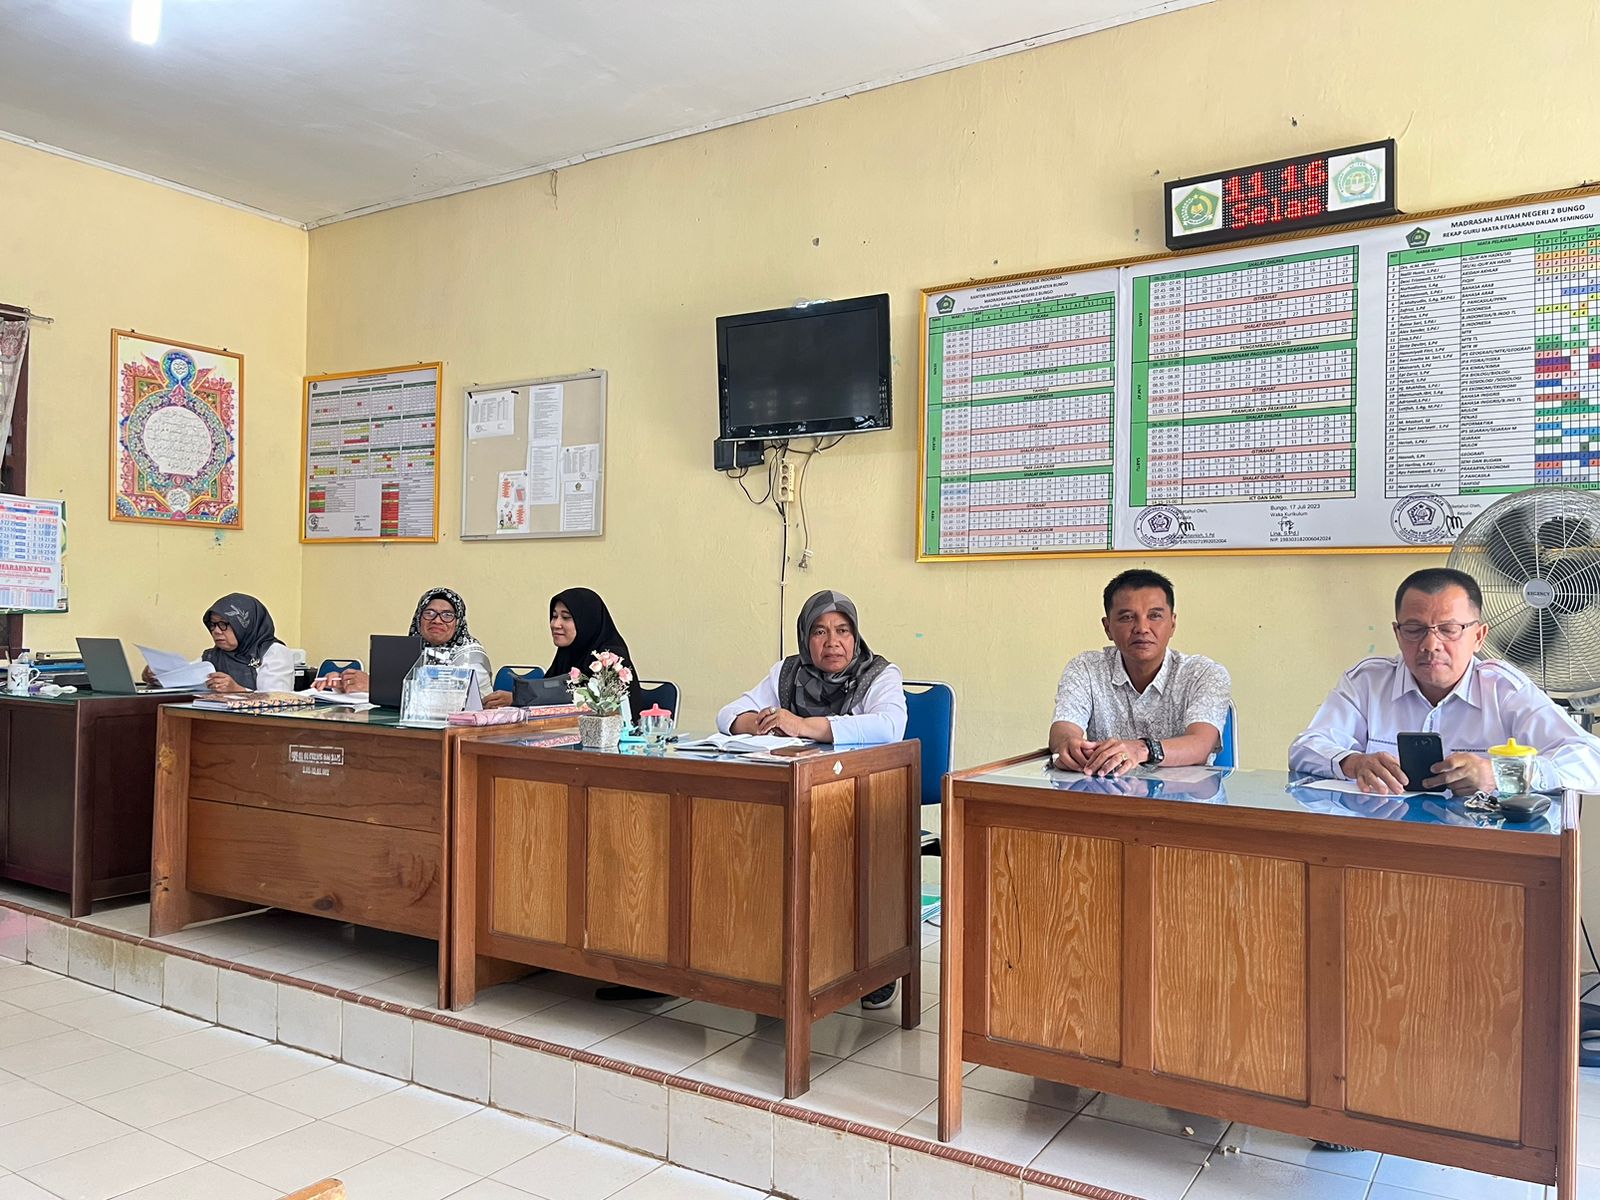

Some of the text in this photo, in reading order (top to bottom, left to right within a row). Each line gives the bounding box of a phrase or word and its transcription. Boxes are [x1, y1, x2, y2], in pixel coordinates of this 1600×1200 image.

[1451, 217, 1493, 228] MADRASAH
[1494, 213, 1520, 222] ALIYAH
[1522, 209, 1549, 218] NEGERI
[1557, 204, 1585, 213] BUNGO
[1500, 221, 1534, 229] PELAJARAN
[1560, 214, 1594, 222] SEMINGGU
